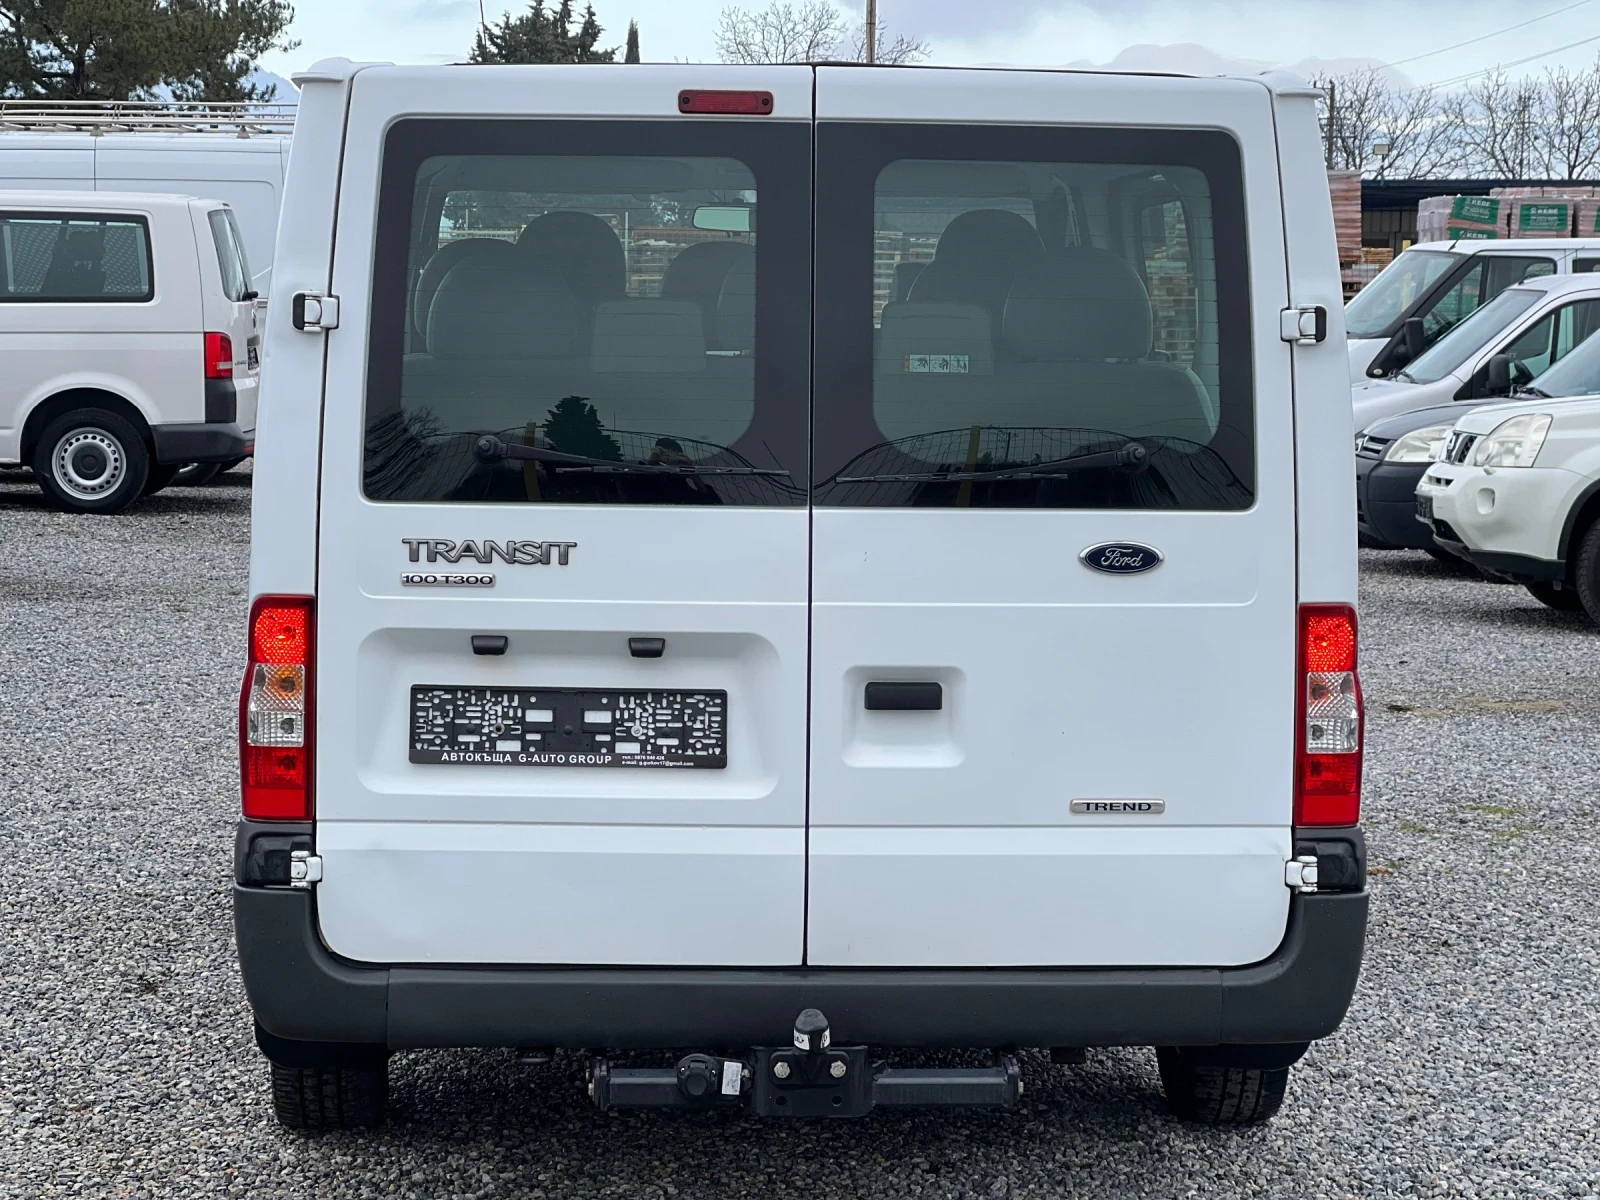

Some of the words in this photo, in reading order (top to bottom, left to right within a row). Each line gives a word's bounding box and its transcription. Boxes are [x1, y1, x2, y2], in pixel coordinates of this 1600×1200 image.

[402, 538, 577, 565] TRANSIT
[1101, 547, 1143, 566] Ford
[403, 575, 437, 584] 100
[440, 575, 493, 585] T300
[441, 752, 512, 763] АВТОКЪЩА
[518, 753, 566, 763] G-AUTO
[569, 754, 612, 764] GROUP
[1082, 802, 1152, 811] TREND
